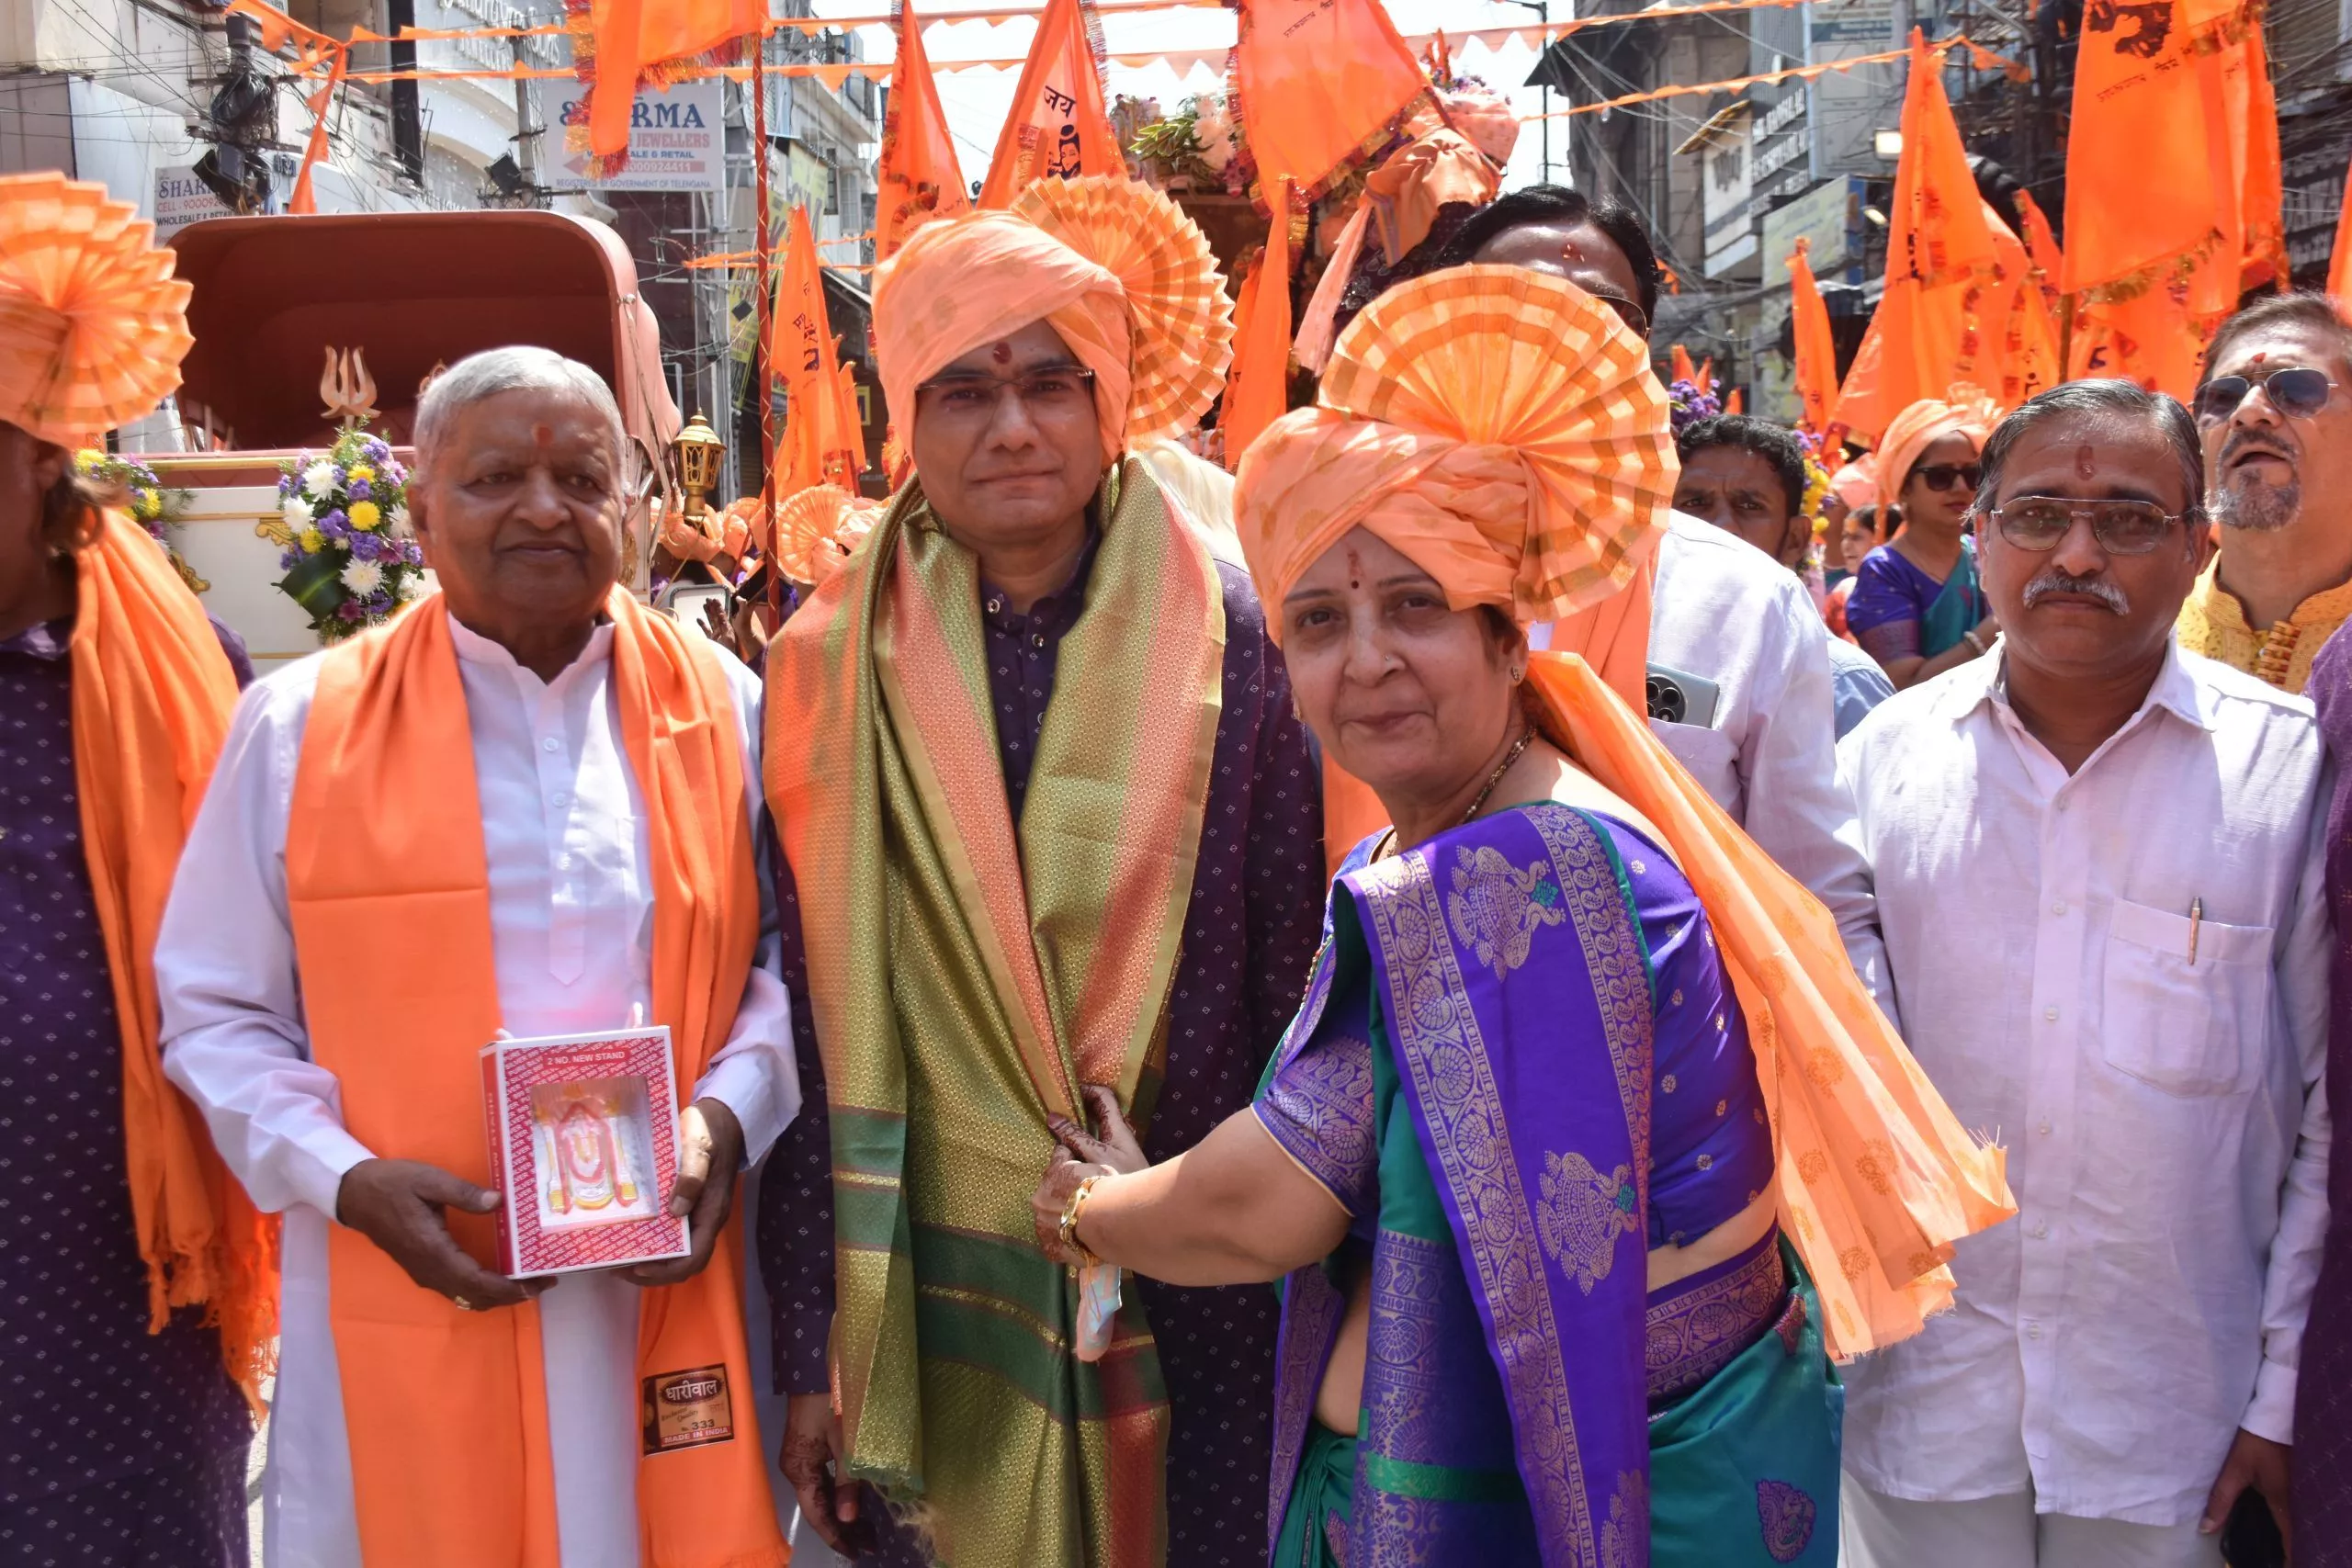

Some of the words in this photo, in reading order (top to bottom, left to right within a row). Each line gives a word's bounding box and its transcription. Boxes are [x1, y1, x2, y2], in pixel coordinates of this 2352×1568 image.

[1044, 85, 1076, 118] जय
[560, 101, 706, 128] SRMA
[637, 132, 710, 148] JEWELLERS
[159, 178, 212, 198] SHAR
[157, 200, 176, 213] CELL
[184, 197, 220, 209] 900092
[157, 213, 201, 226] WHOLESALE
[573, 1054, 594, 1063] NEW
[595, 1051, 625, 1062] STAND
[666, 1380, 717, 1401] धारीवाल
[691, 1419, 715, 1430] 333
[664, 1433, 691, 1443] MADE
[706, 1427, 728, 1436] INDIA
